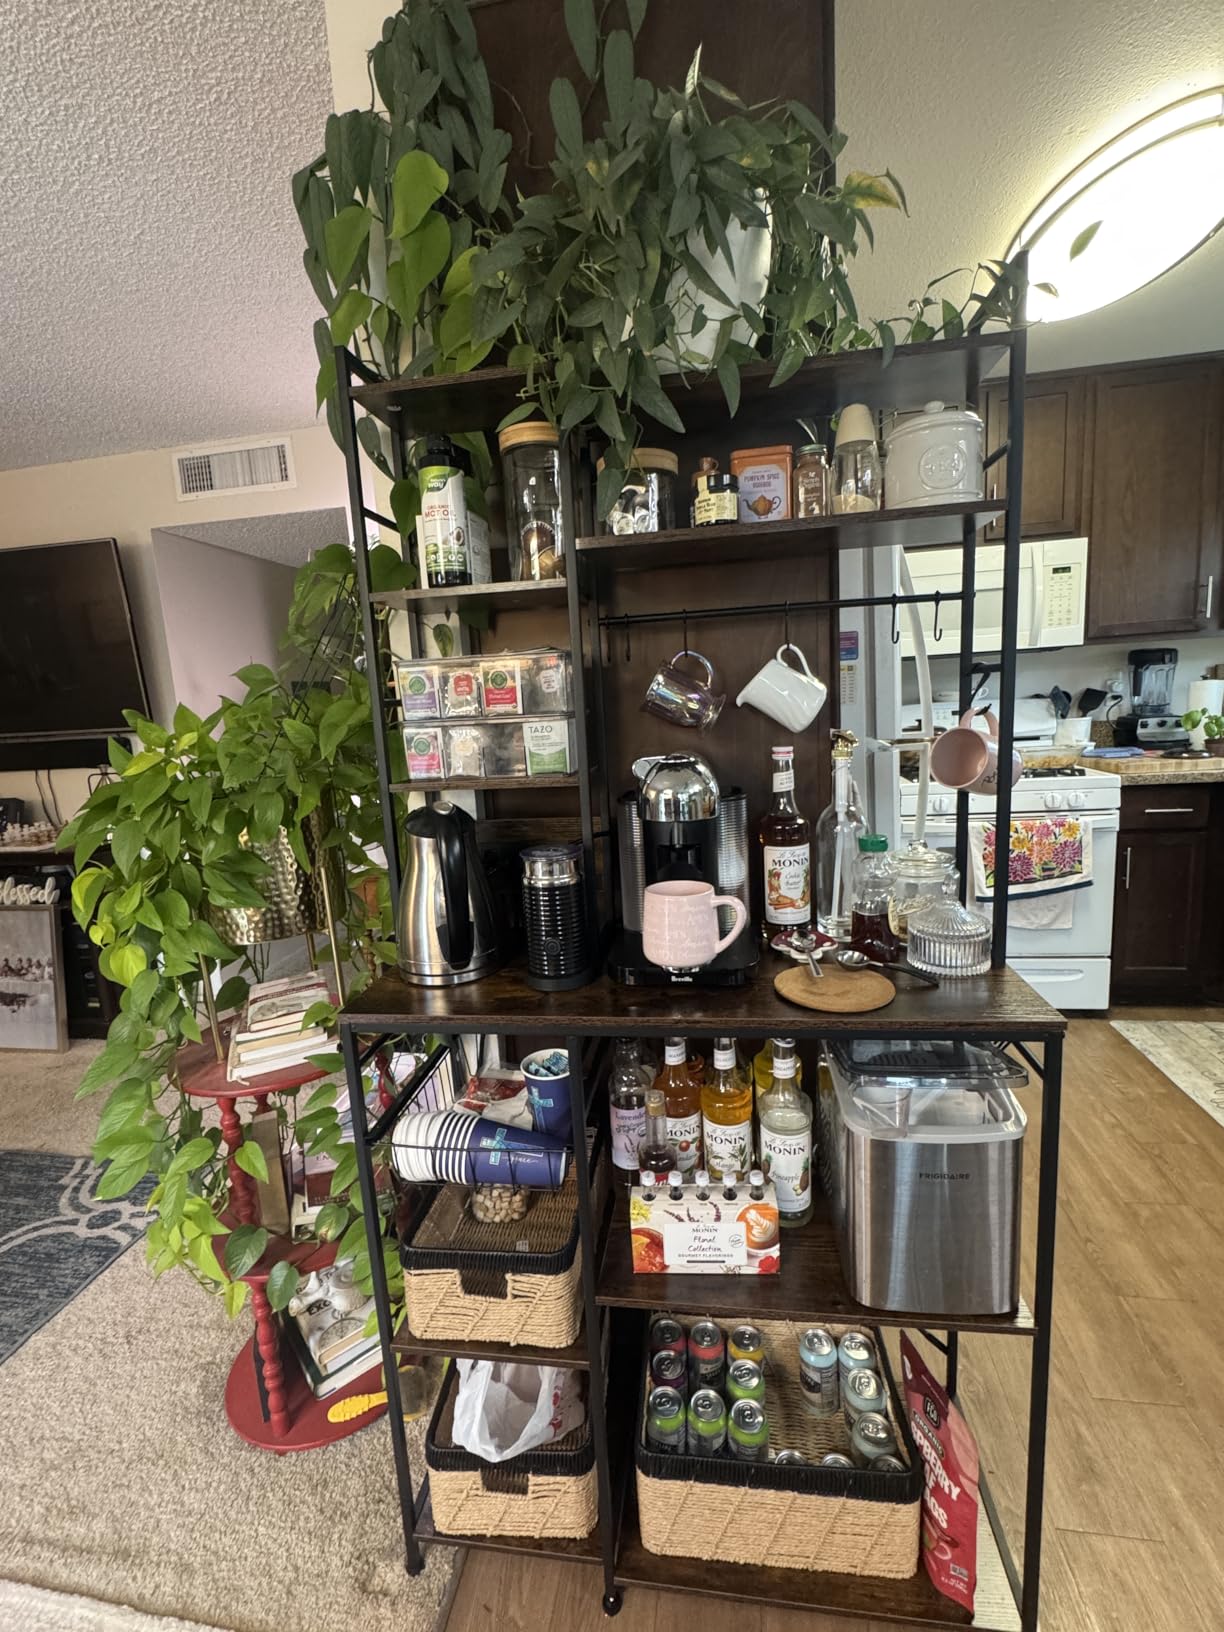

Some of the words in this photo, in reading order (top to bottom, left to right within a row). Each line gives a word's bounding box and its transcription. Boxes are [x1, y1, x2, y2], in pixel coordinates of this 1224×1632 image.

[528, 724, 553, 734] TAZO
[771, 857, 809, 868] MONIN
[706, 1131, 745, 1145] MONIN
[764, 1140, 806, 1156] MONIN
[919, 1172, 970, 1180] FRIGIDAIRE
[693, 1235, 716, 1243] Floral
[688, 1244, 722, 1253] Collection
[914, 1413, 943, 1454] ORGANIC
